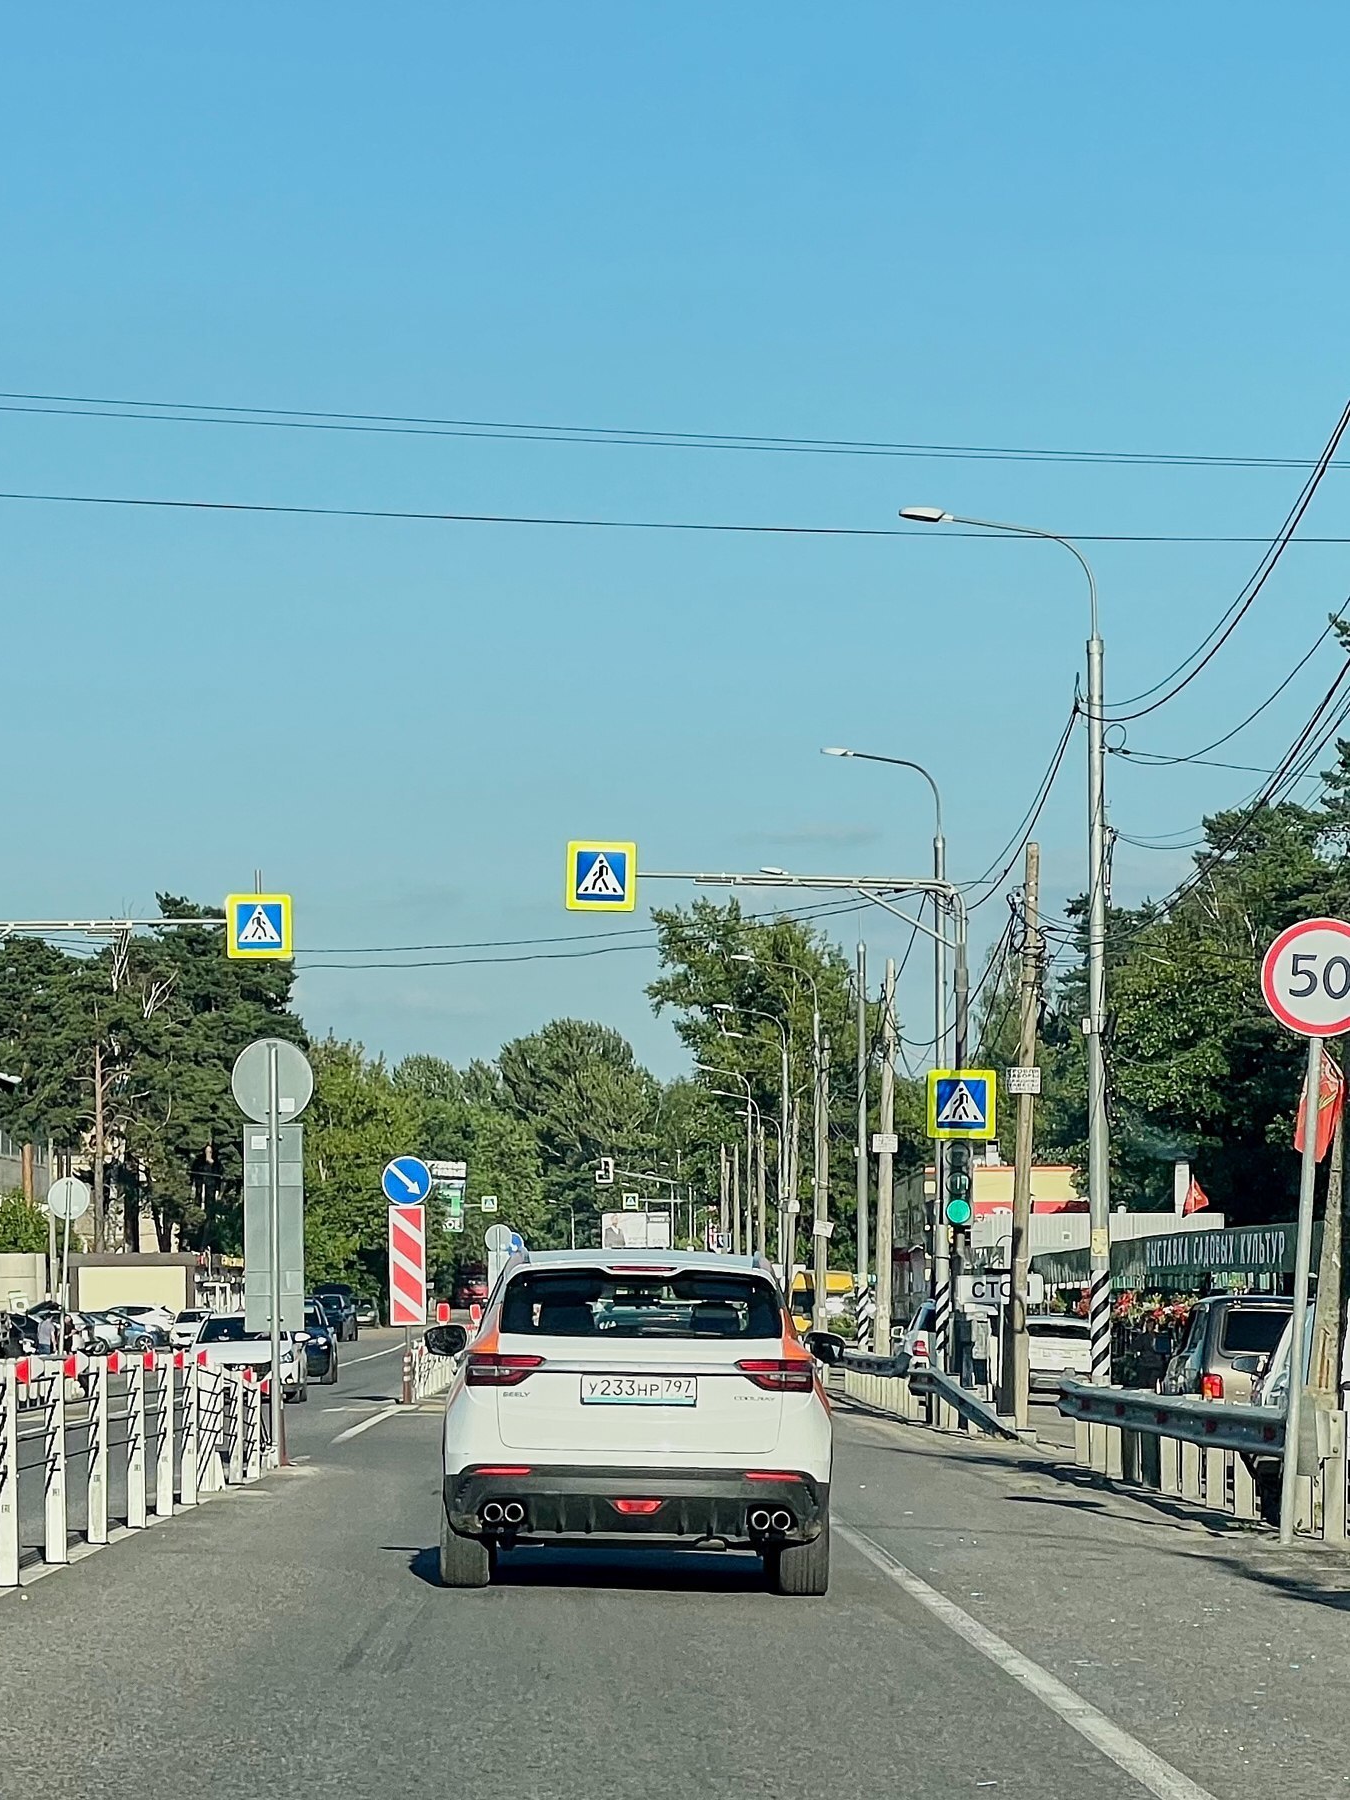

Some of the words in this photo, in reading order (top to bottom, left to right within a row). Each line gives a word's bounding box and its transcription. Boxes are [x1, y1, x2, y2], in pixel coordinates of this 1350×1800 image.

[1288, 953, 1350, 999] 50
[1146, 1237, 1188, 1267] ВЫСТАВКА
[1193, 1235, 1234, 1267] САДОВЫХ
[1240, 1231, 1285, 1264] КУЛЬТУР
[972, 1281, 1030, 1298] СТО
